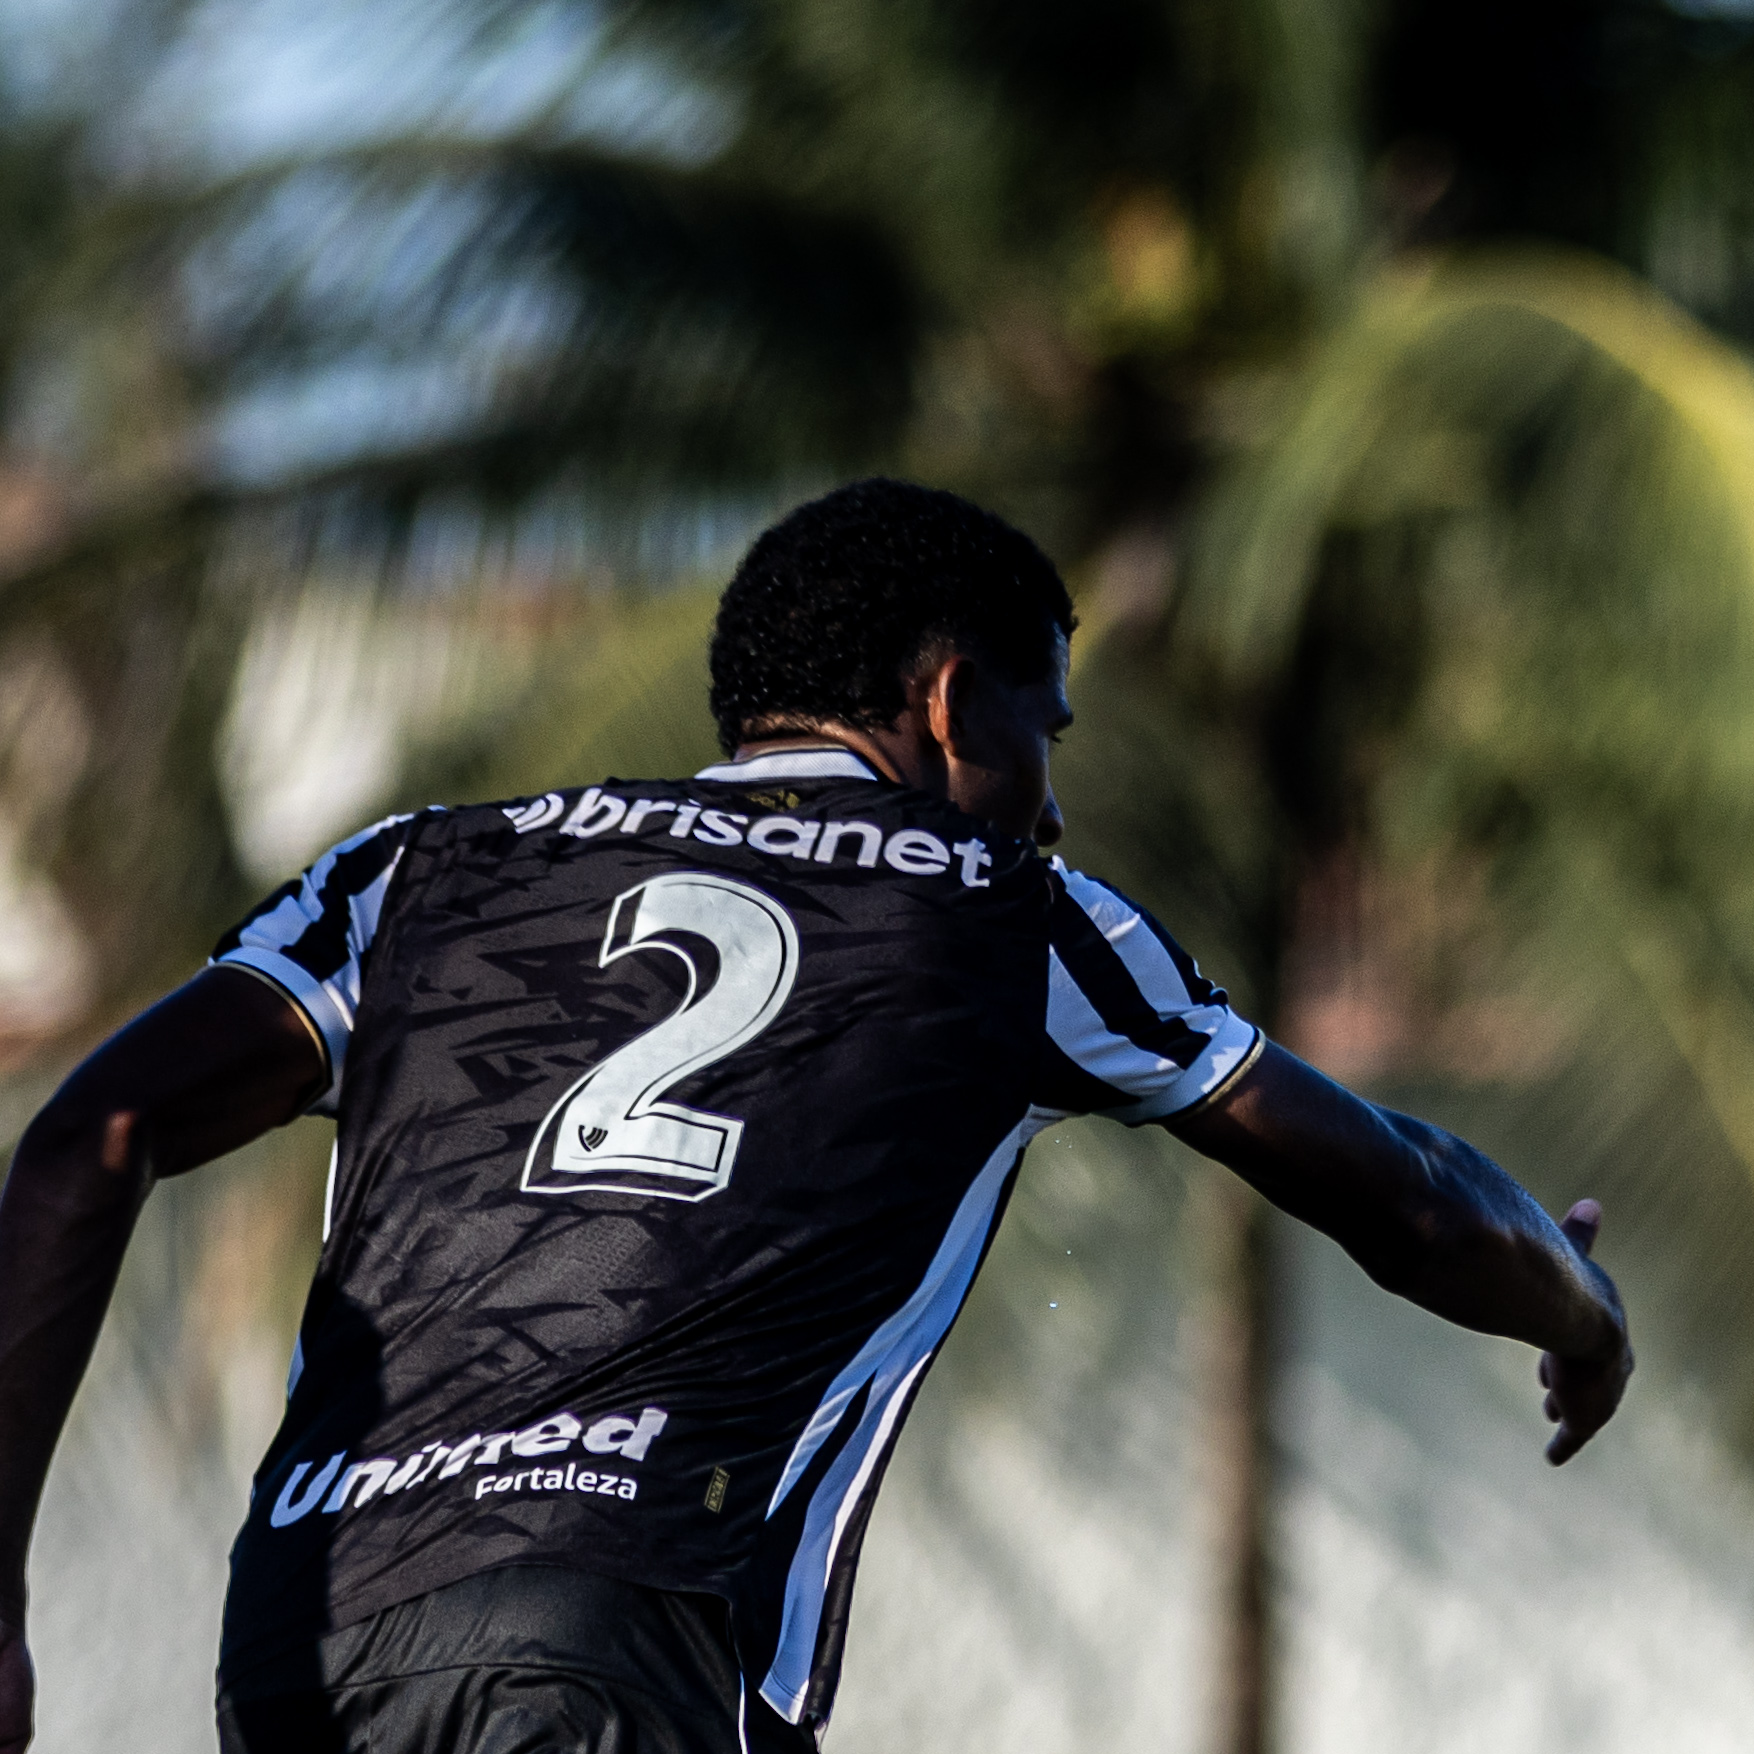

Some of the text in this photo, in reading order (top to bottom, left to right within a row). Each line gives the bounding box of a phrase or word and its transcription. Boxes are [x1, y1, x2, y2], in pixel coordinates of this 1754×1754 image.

[558, 788, 993, 887] brisanet
[519, 871, 800, 1202] 2
[474, 1463, 639, 1501] Fortaleza
